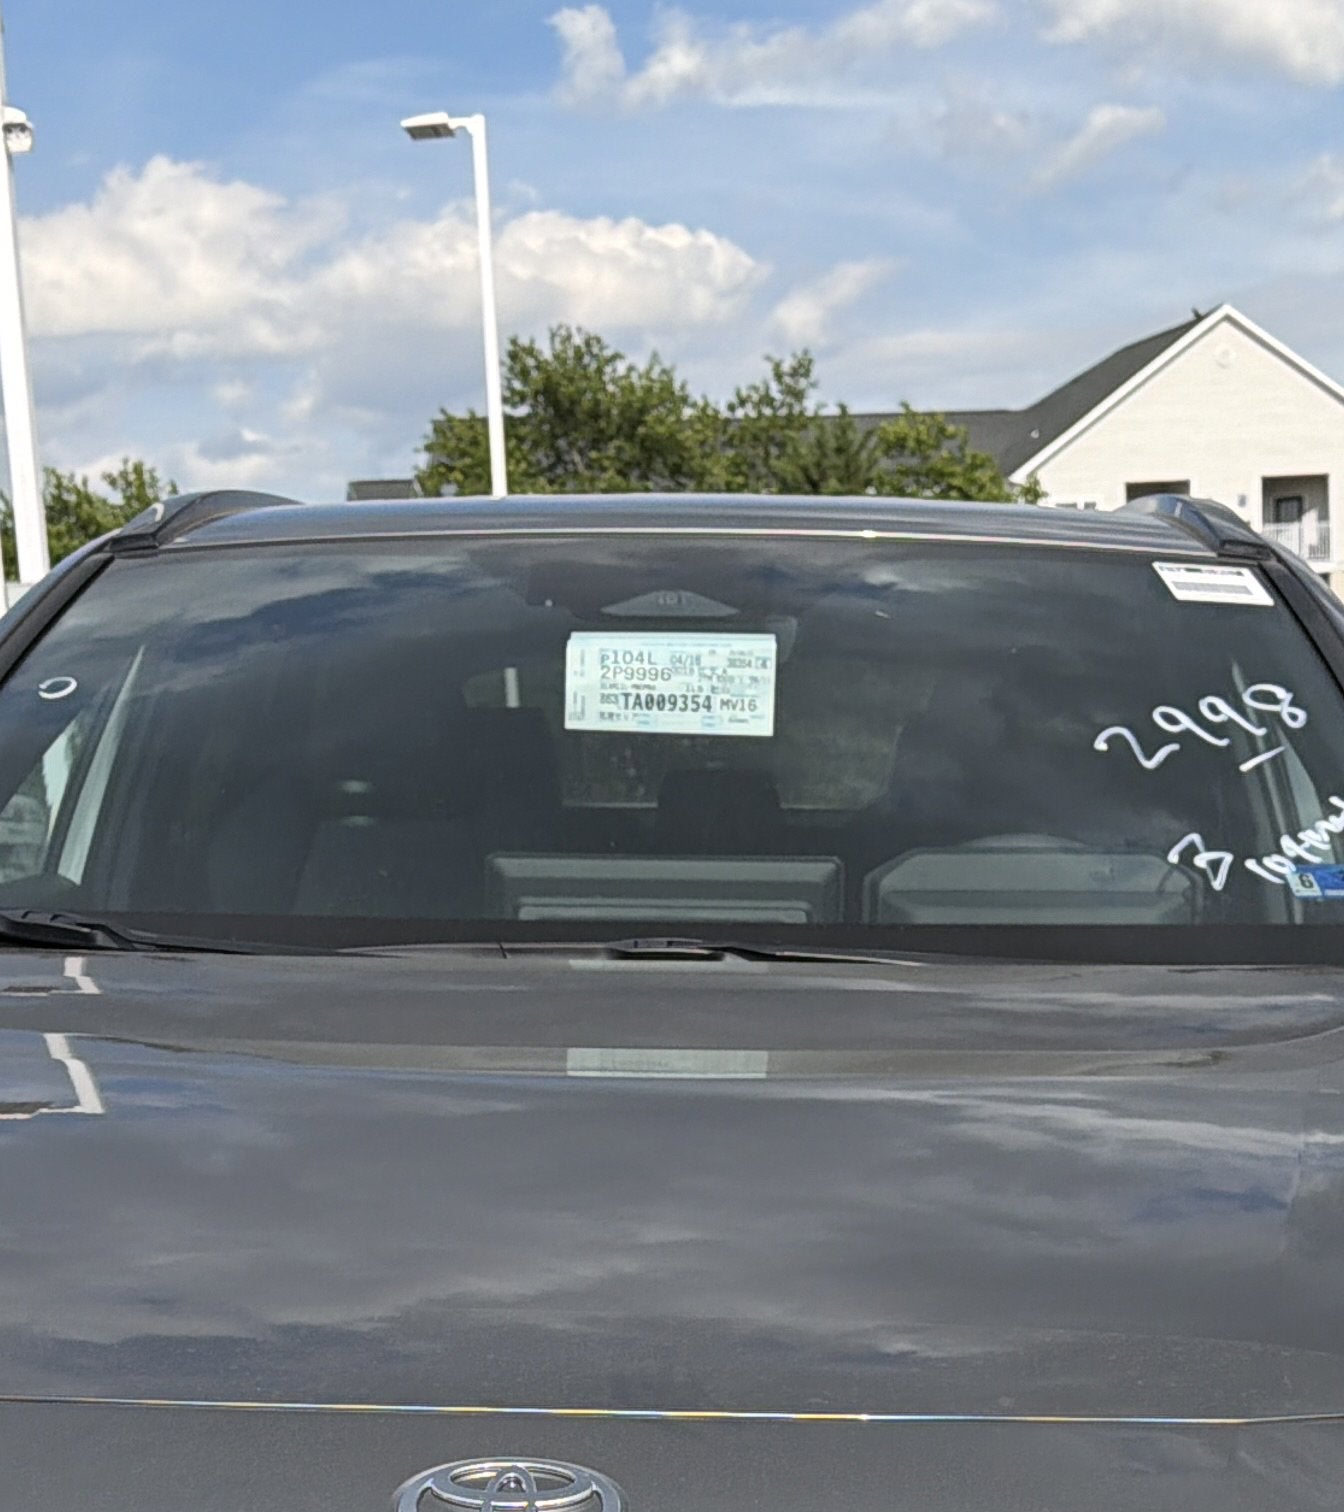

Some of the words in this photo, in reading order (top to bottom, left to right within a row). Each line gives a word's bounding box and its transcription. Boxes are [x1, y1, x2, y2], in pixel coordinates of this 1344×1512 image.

[600, 665, 672, 681] 2P9996
[621, 692, 712, 712] TA009354
[719, 698, 758, 712] MV16
[1094, 683, 1308, 770] 2998
